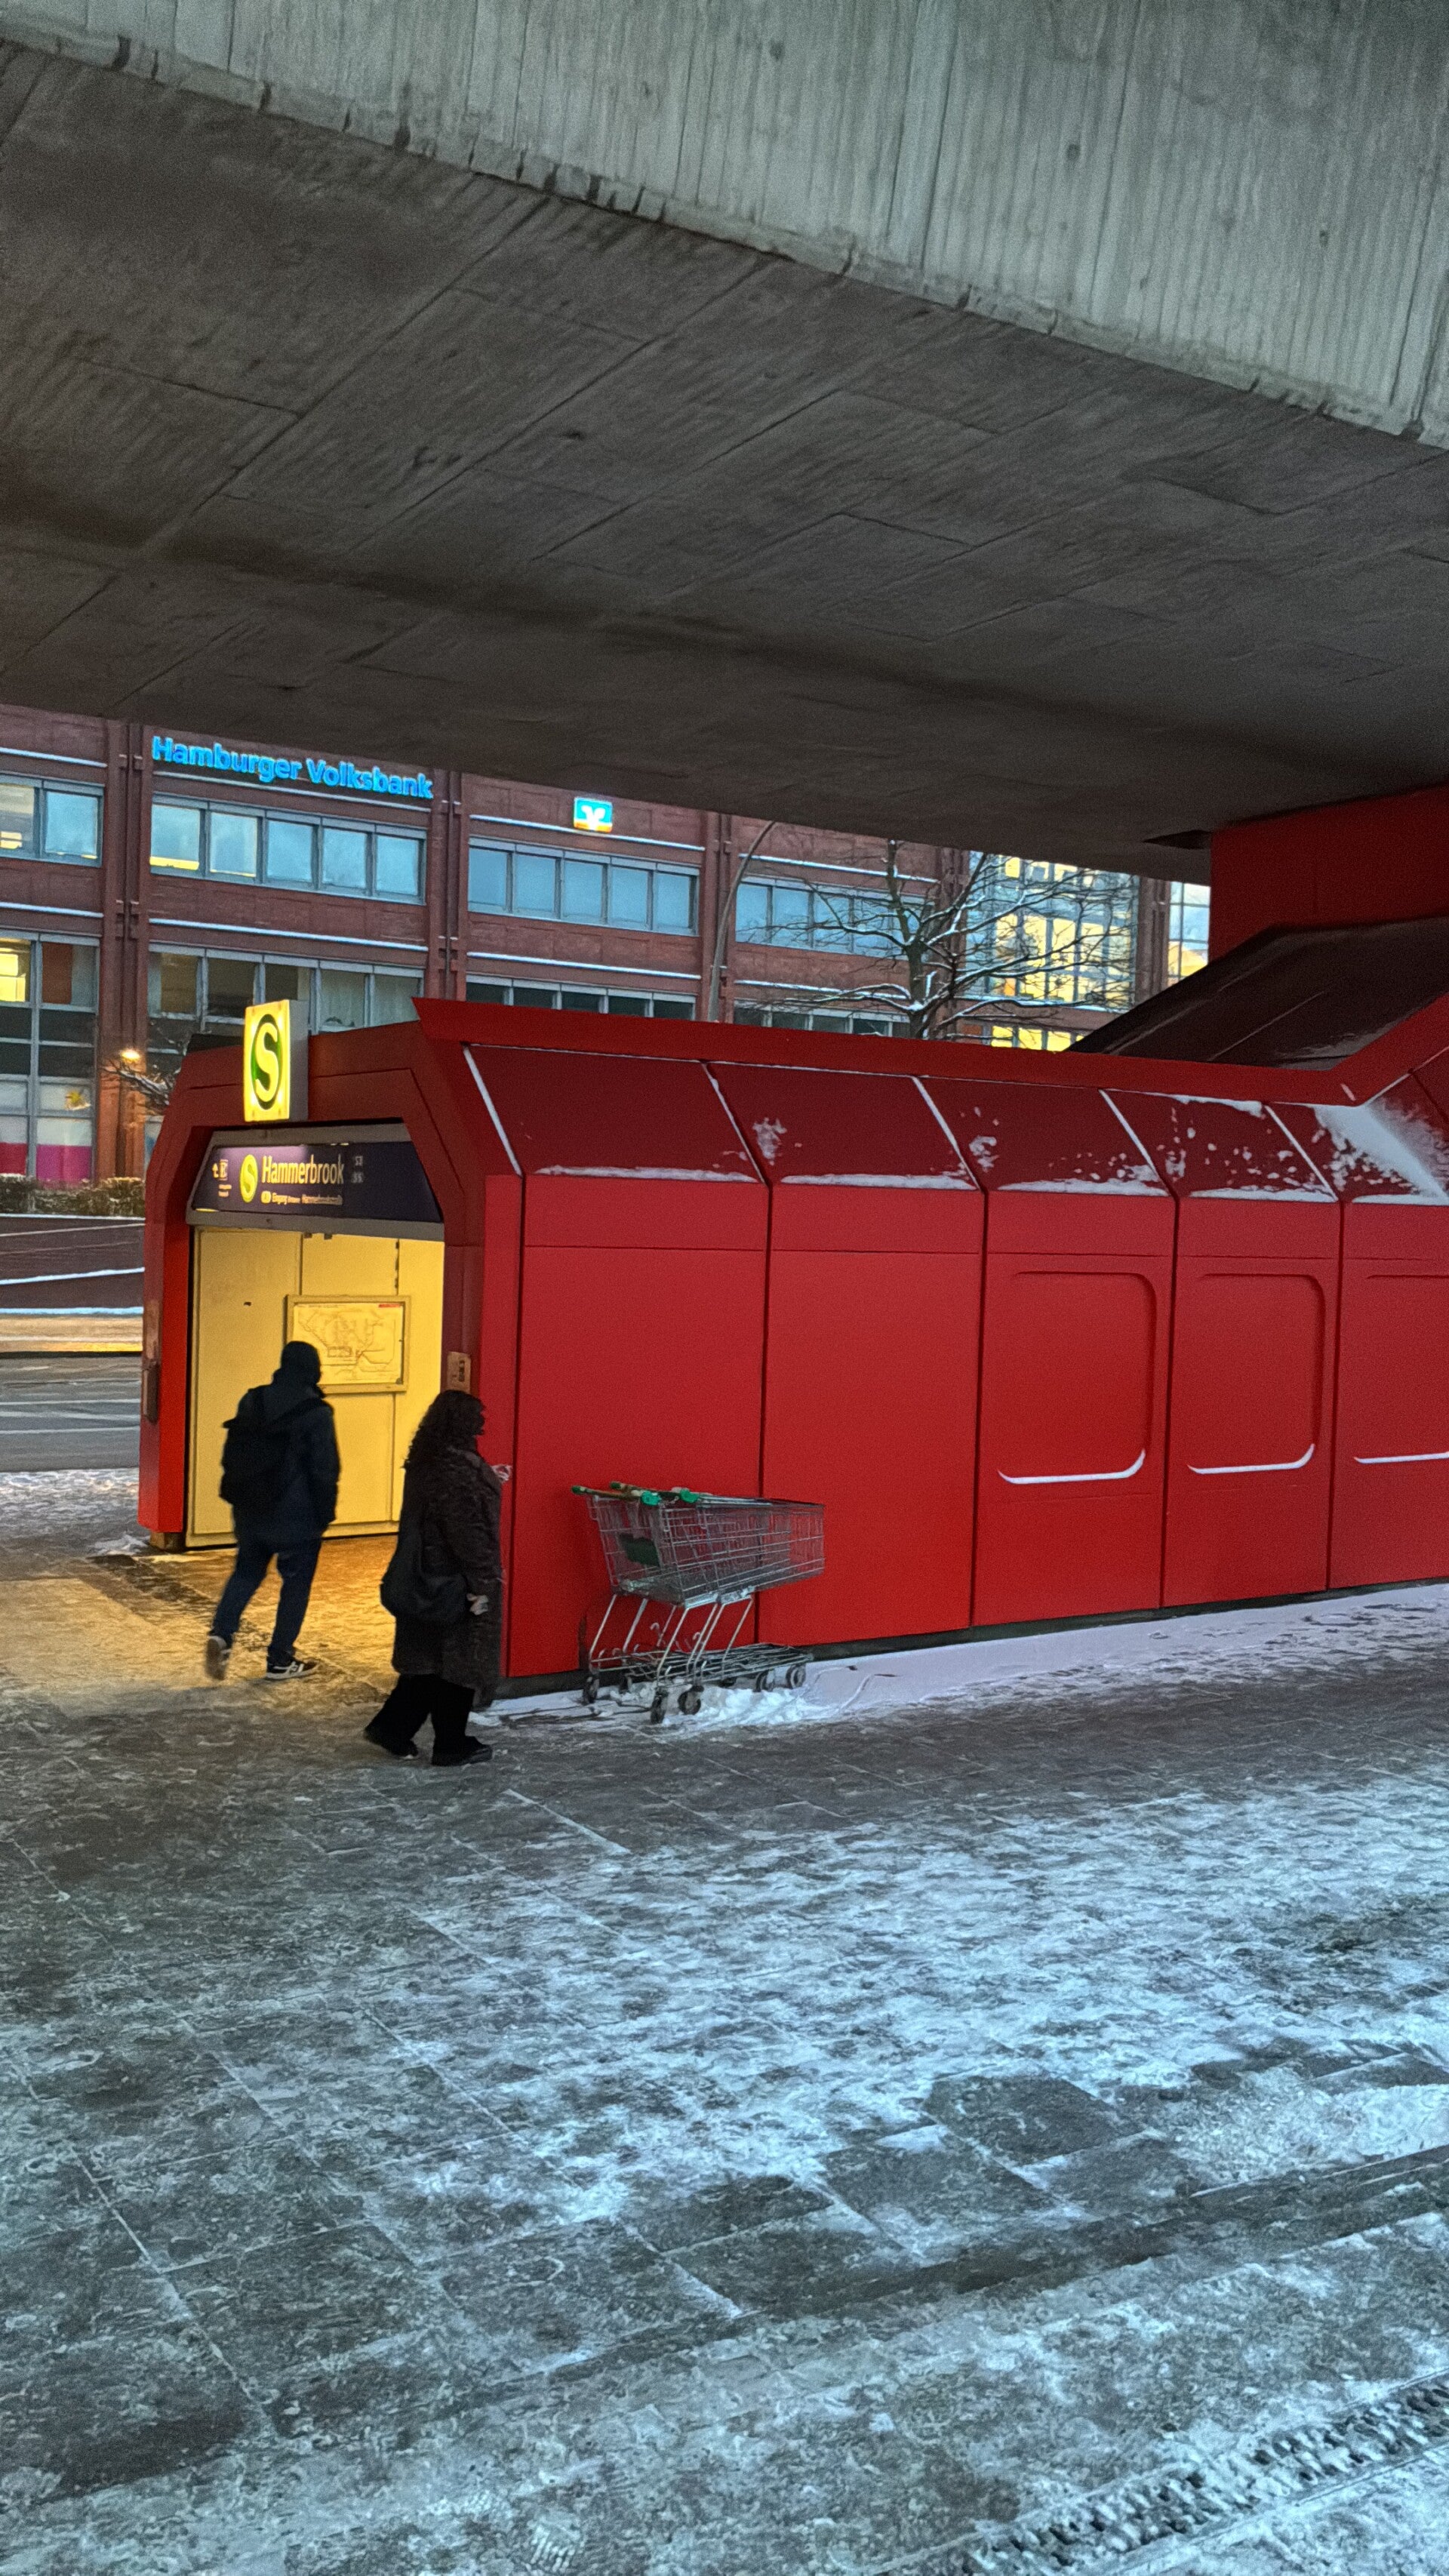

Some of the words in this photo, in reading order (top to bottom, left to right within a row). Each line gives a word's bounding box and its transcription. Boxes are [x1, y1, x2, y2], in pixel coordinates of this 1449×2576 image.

[152, 736, 303, 783] Hamburger
[306, 758, 434, 799] Volksbank
[254, 1022, 280, 1103] S
[242, 1156, 257, 1200] S
[261, 1154, 345, 1184] Hammerbrook
